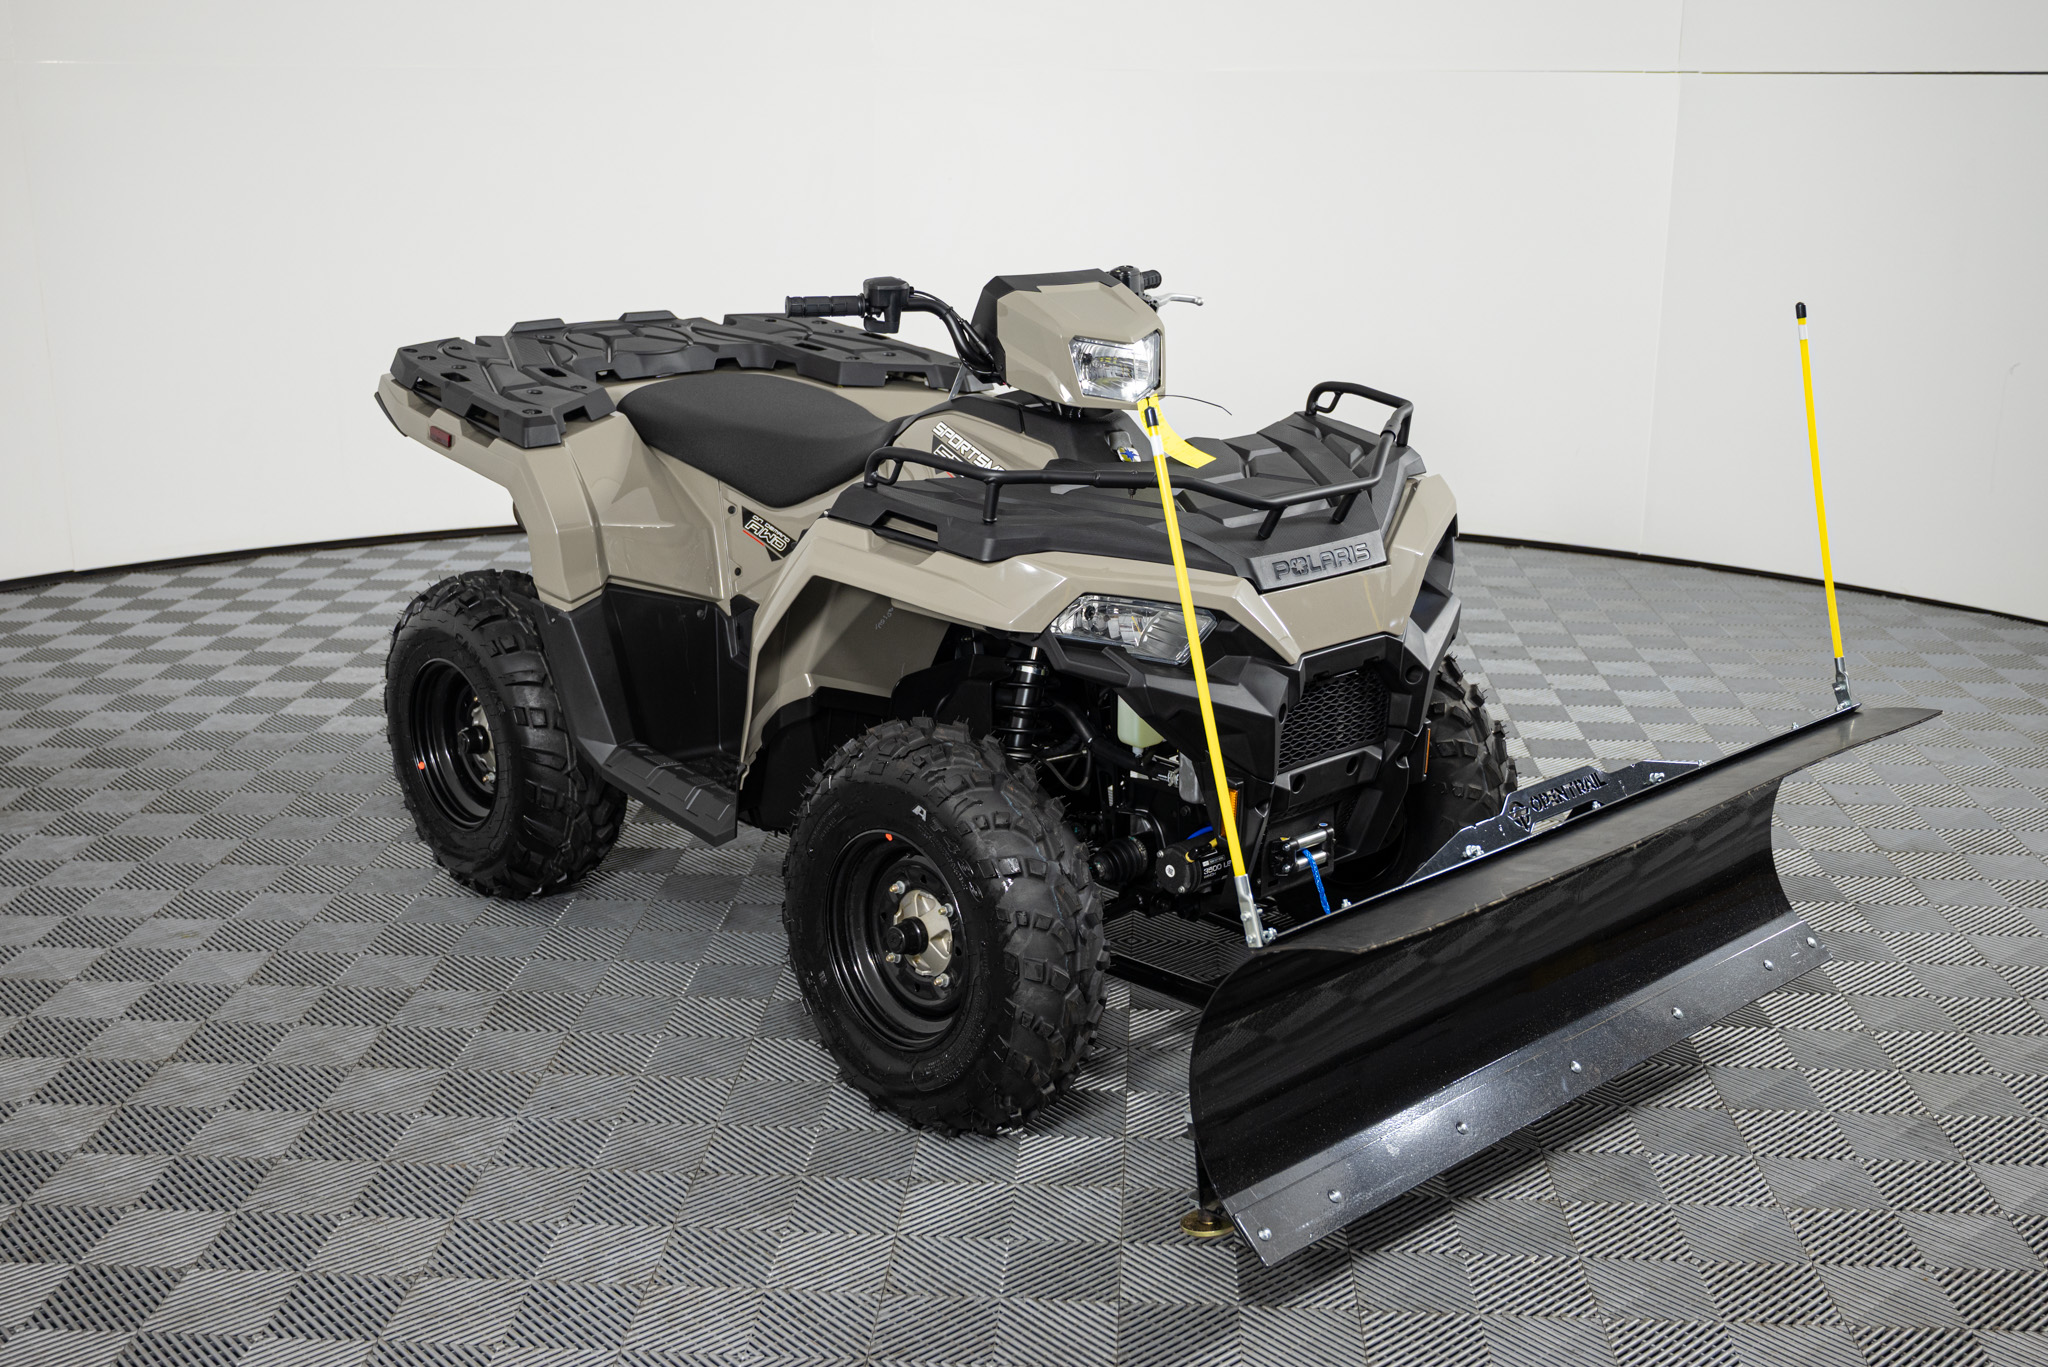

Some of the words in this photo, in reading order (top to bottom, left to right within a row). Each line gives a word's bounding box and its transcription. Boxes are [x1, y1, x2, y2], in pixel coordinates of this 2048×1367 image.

[932, 421, 1006, 471] SPORTSM
[744, 519, 788, 552] AWD
[1272, 542, 1371, 580] POLARIS
